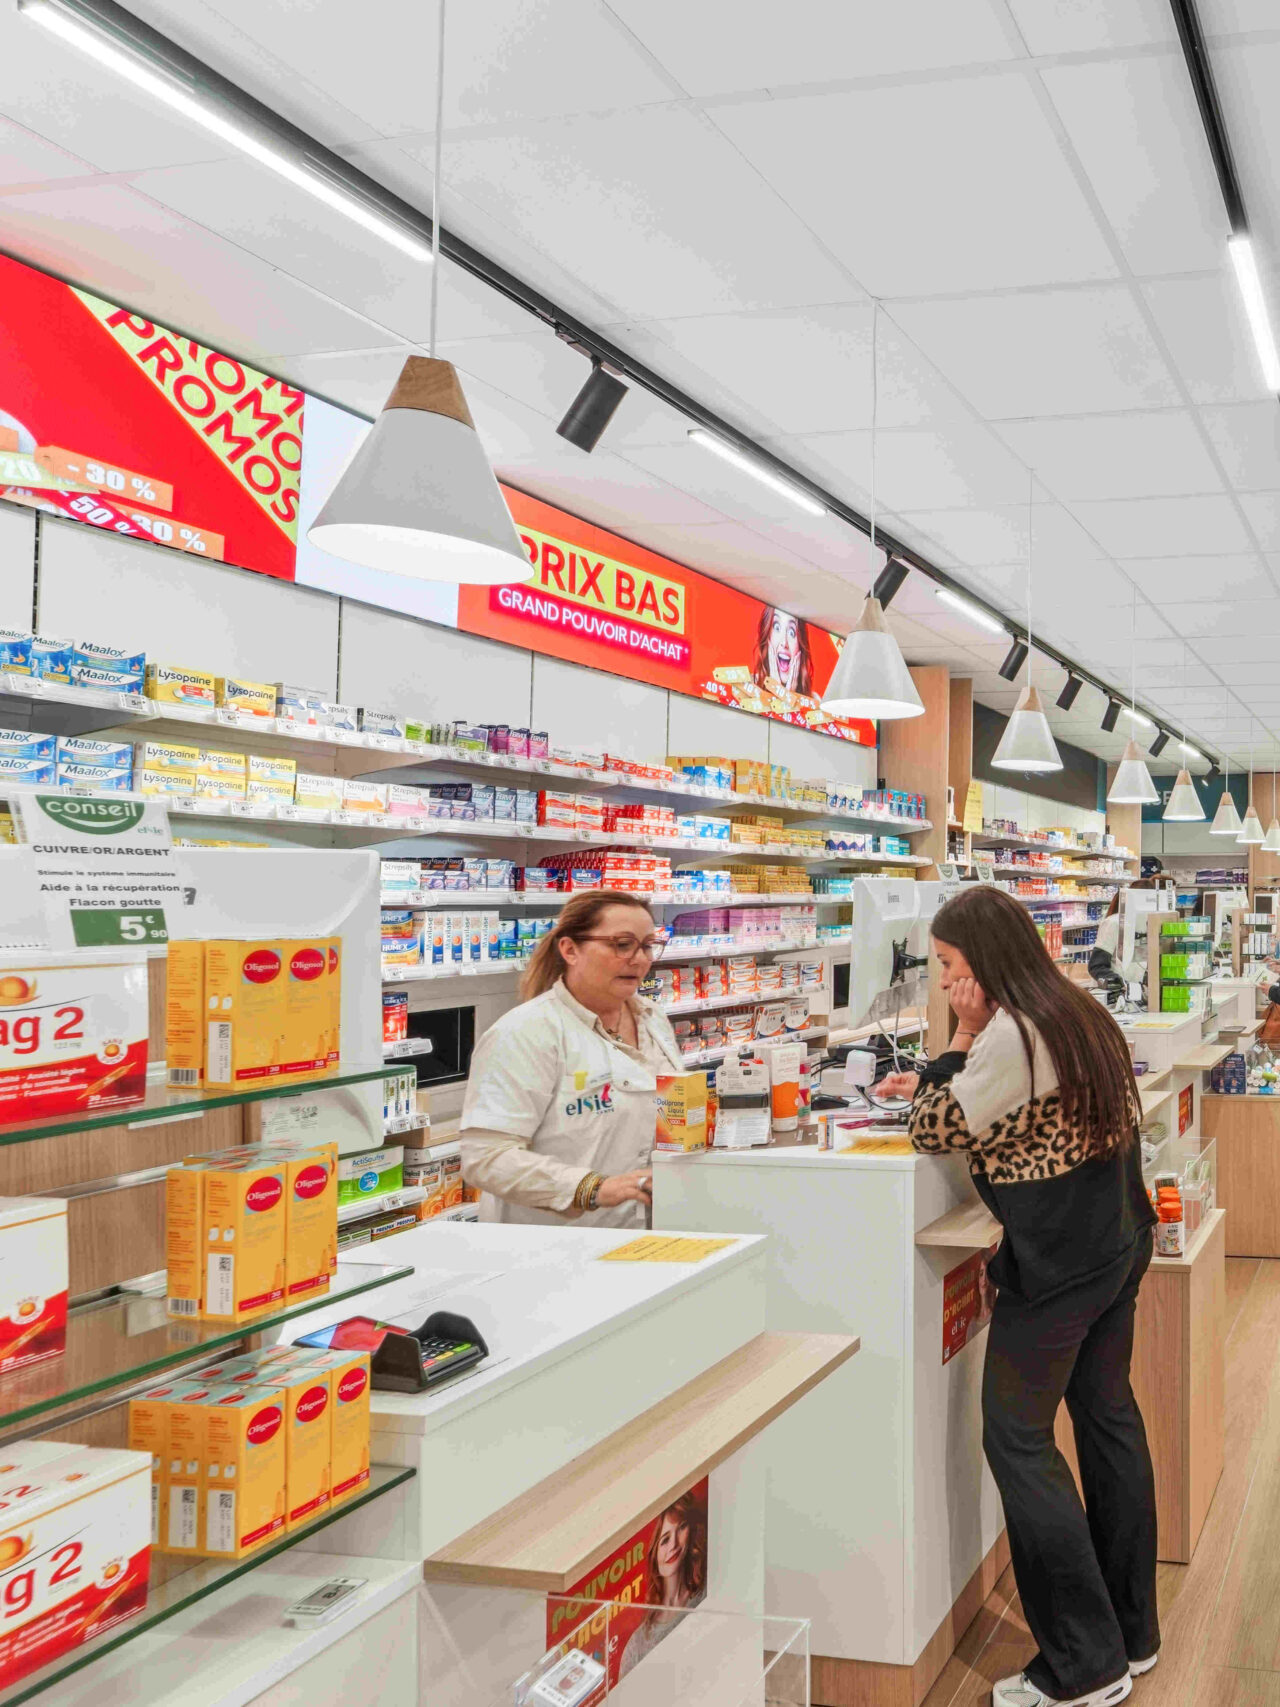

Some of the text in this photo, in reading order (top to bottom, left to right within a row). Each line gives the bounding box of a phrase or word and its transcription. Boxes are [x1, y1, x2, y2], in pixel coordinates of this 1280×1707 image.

[86, 462, 156, 501] 30 %
[70, 495, 114, 525] 50
[180, 528, 206, 552] %
[614, 569, 681, 626] BAS
[498, 587, 560, 622] GRAND
[562, 608, 628, 643] POUVOIR
[32, 636, 66, 649] Maalox
[80, 642, 126, 658] Maalox
[78, 668, 125, 683] Maalox
[159, 669, 212, 687] Lysopaine
[227, 684, 275, 701] Lysopaine
[366, 710, 397, 721] Strepsils
[65, 738, 112, 752] Maalox
[147, 746, 196, 760] Lysopaine
[65, 764, 112, 778] Maalox
[251, 760, 294, 771] Lysopaine
[143, 771, 192, 785] Lysopaine
[197, 777, 243, 790] Lysopaine
[249, 785, 291, 796] Lysopaine
[46, 801, 137, 818] conseil
[40, 883, 181, 893] Aide à la récupération
[69, 899, 162, 908] Flacon goutte
[382, 944, 409, 952] HUMEX
[244, 961, 280, 973] Oligosol
[291, 960, 324, 971] Oligosol
[53, 1006, 85, 1040] 2
[295, 1175, 327, 1189] Oligosol
[246, 1187, 281, 1201] Oligosol
[0, 1541, 83, 1618] g 2
[552, 1542, 645, 1634] POUVOIR
